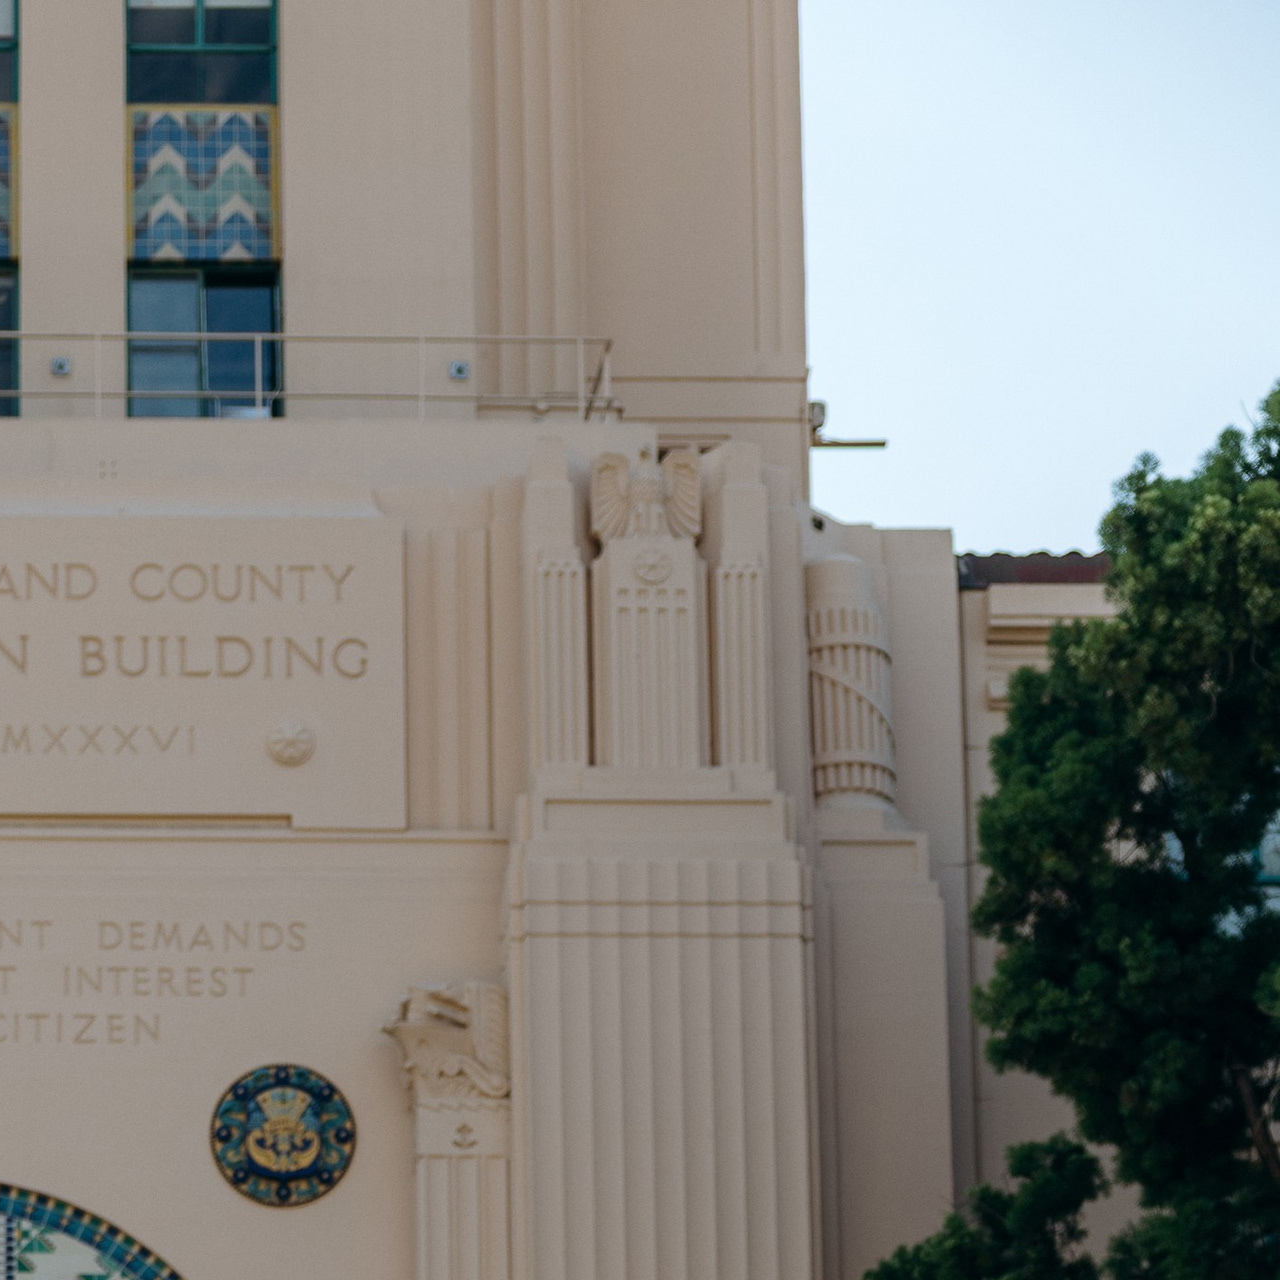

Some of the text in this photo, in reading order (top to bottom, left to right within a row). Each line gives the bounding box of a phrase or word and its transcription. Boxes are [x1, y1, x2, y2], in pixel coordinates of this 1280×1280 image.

[129, 562, 355, 602] COUNTY
[79, 634, 369, 679] BUILDING
[98, 919, 308, 952] DEMANDS
[63, 965, 254, 998] INTEREST
